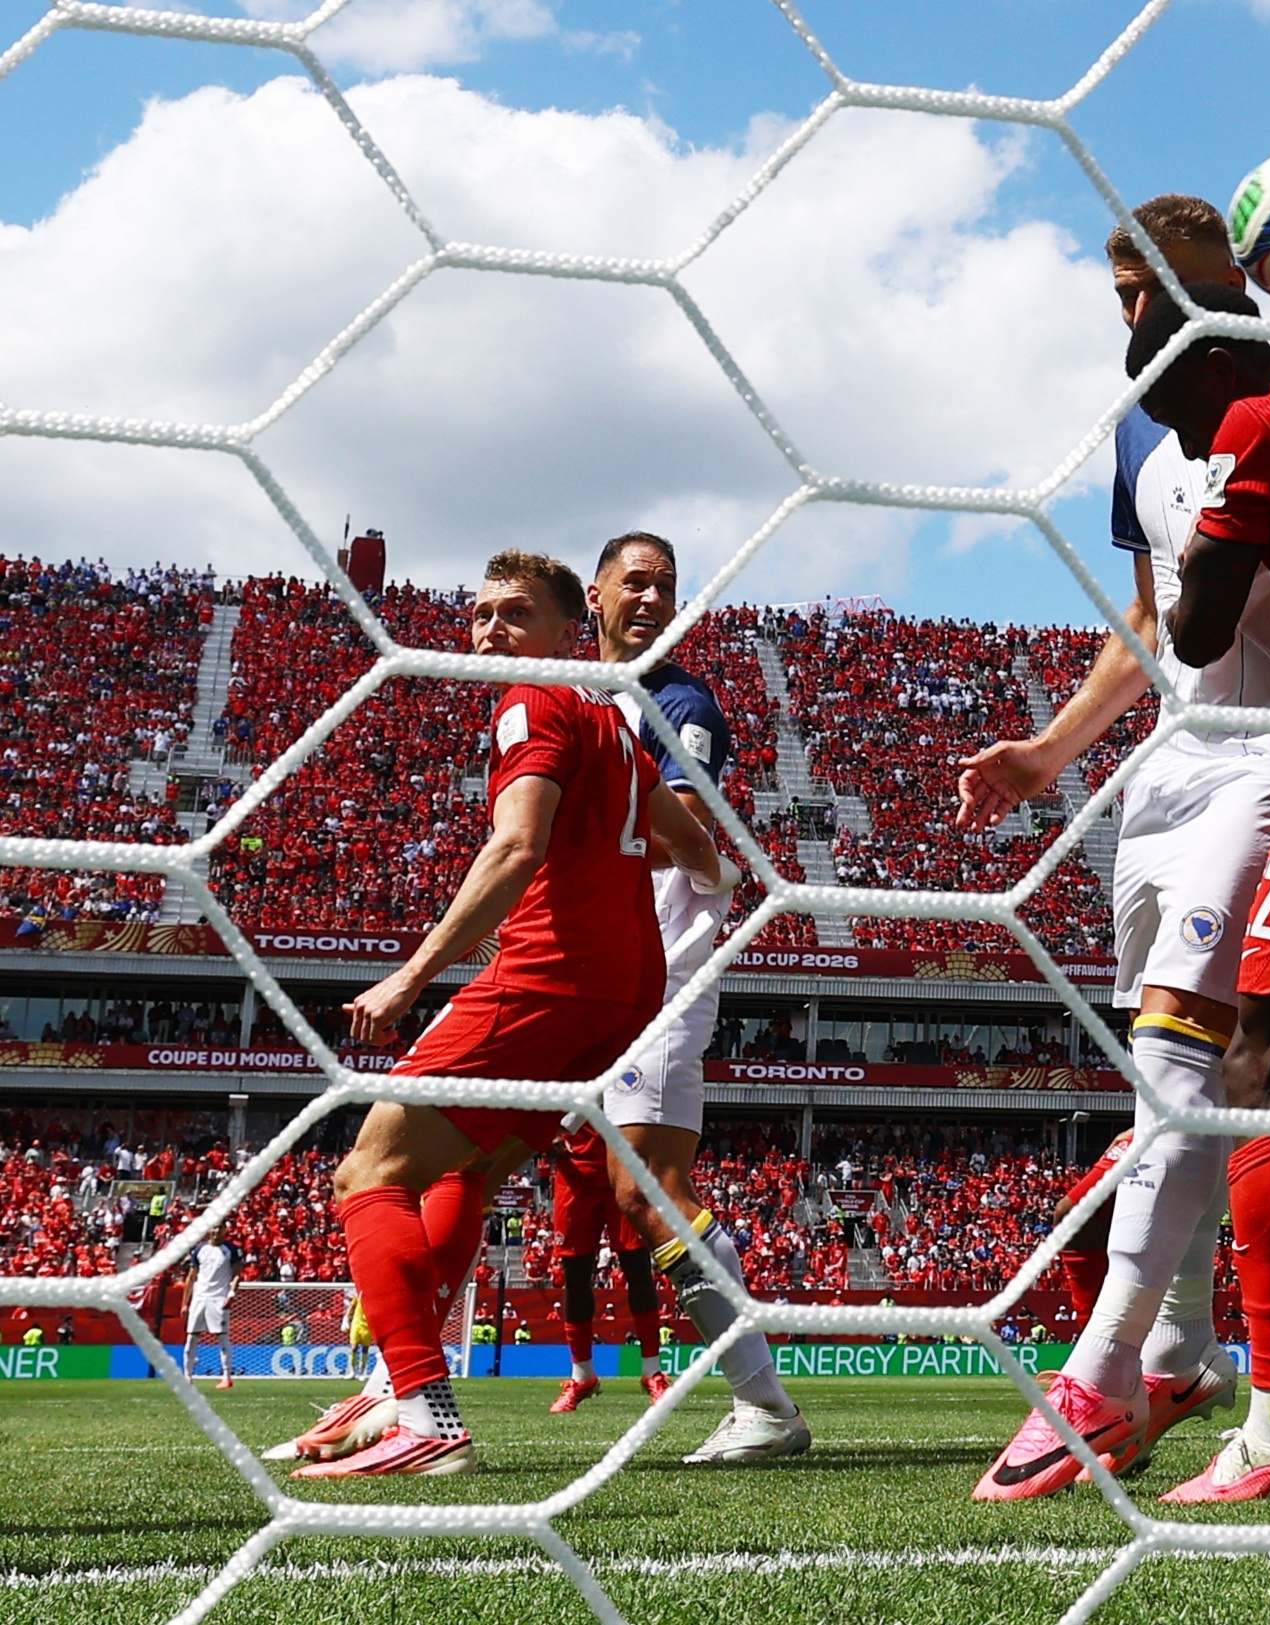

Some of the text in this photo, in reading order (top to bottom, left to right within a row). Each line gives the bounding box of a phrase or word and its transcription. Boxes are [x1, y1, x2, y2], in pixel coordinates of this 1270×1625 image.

[254, 934, 400, 953] TORONTO
[732, 952, 859, 969] RLD CUP 2026
[1062, 963, 1119, 977] #FIFAWorld
[148, 1050, 208, 1065] COUPE
[211, 1051, 236, 1066] DU
[239, 1052, 304, 1068] MONDE
[358, 1055, 395, 1069] FIFA
[729, 1064, 865, 1080] TORONTO
[776, 1345, 898, 1376] ENERGY
